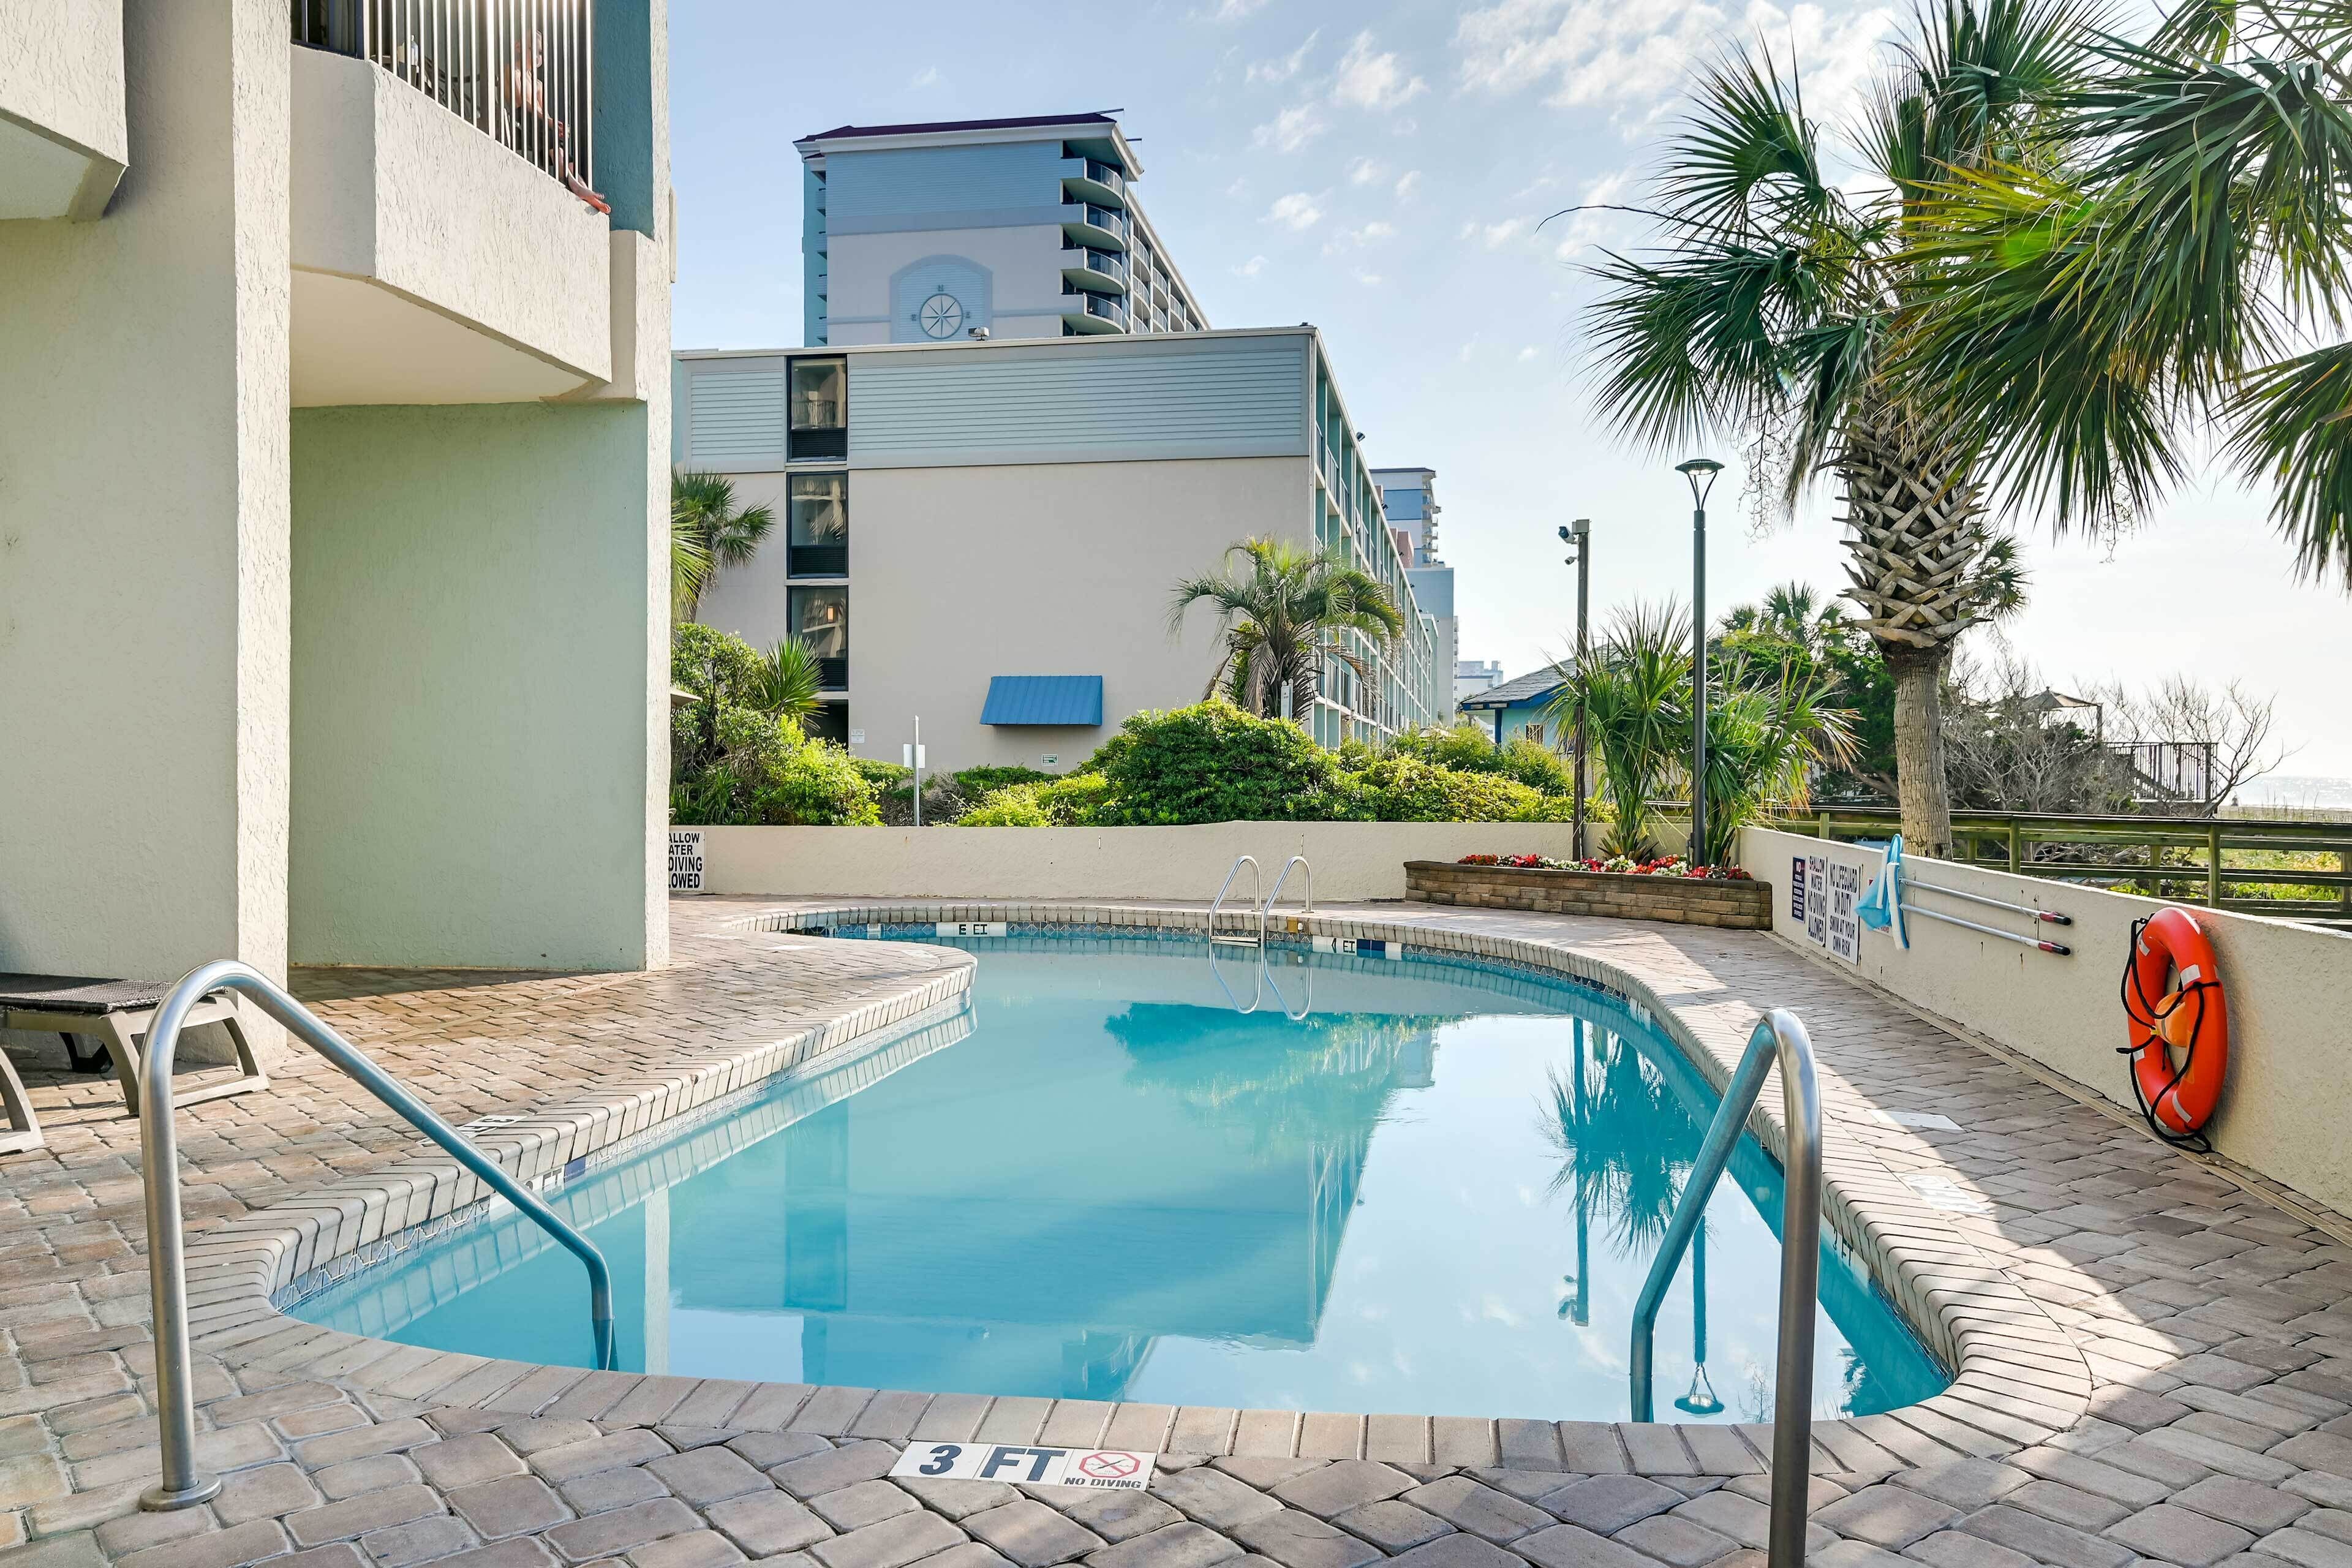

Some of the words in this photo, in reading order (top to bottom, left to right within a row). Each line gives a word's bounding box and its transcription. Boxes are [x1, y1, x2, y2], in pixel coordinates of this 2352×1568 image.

[668, 856, 703, 872] DIVING
[1809, 856, 1825, 874] SHALLOW
[669, 873, 700, 888] OWED
[1811, 873, 1822, 892] WATER
[1830, 863, 1836, 887] NO
[1836, 864, 1857, 893] LIFEGUARD
[1808, 889, 1813, 912] NO
[1814, 892, 1825, 918] DIVING
[1834, 890, 1840, 914] ON
[1841, 892, 1852, 918] DUTY
[1808, 914, 1823, 942] ALLOWED
[1830, 915, 1839, 933] SWIM
[1839, 919, 1845, 935] AT
[1845, 921, 1855, 940] YOUR
[1842, 938, 1850, 957] RISK
[919, 1445, 962, 1475] 3
[980, 1446, 1067, 1482] FT
[1064, 1477, 1086, 1486] NO
[1090, 1479, 1142, 1489] DIVING
